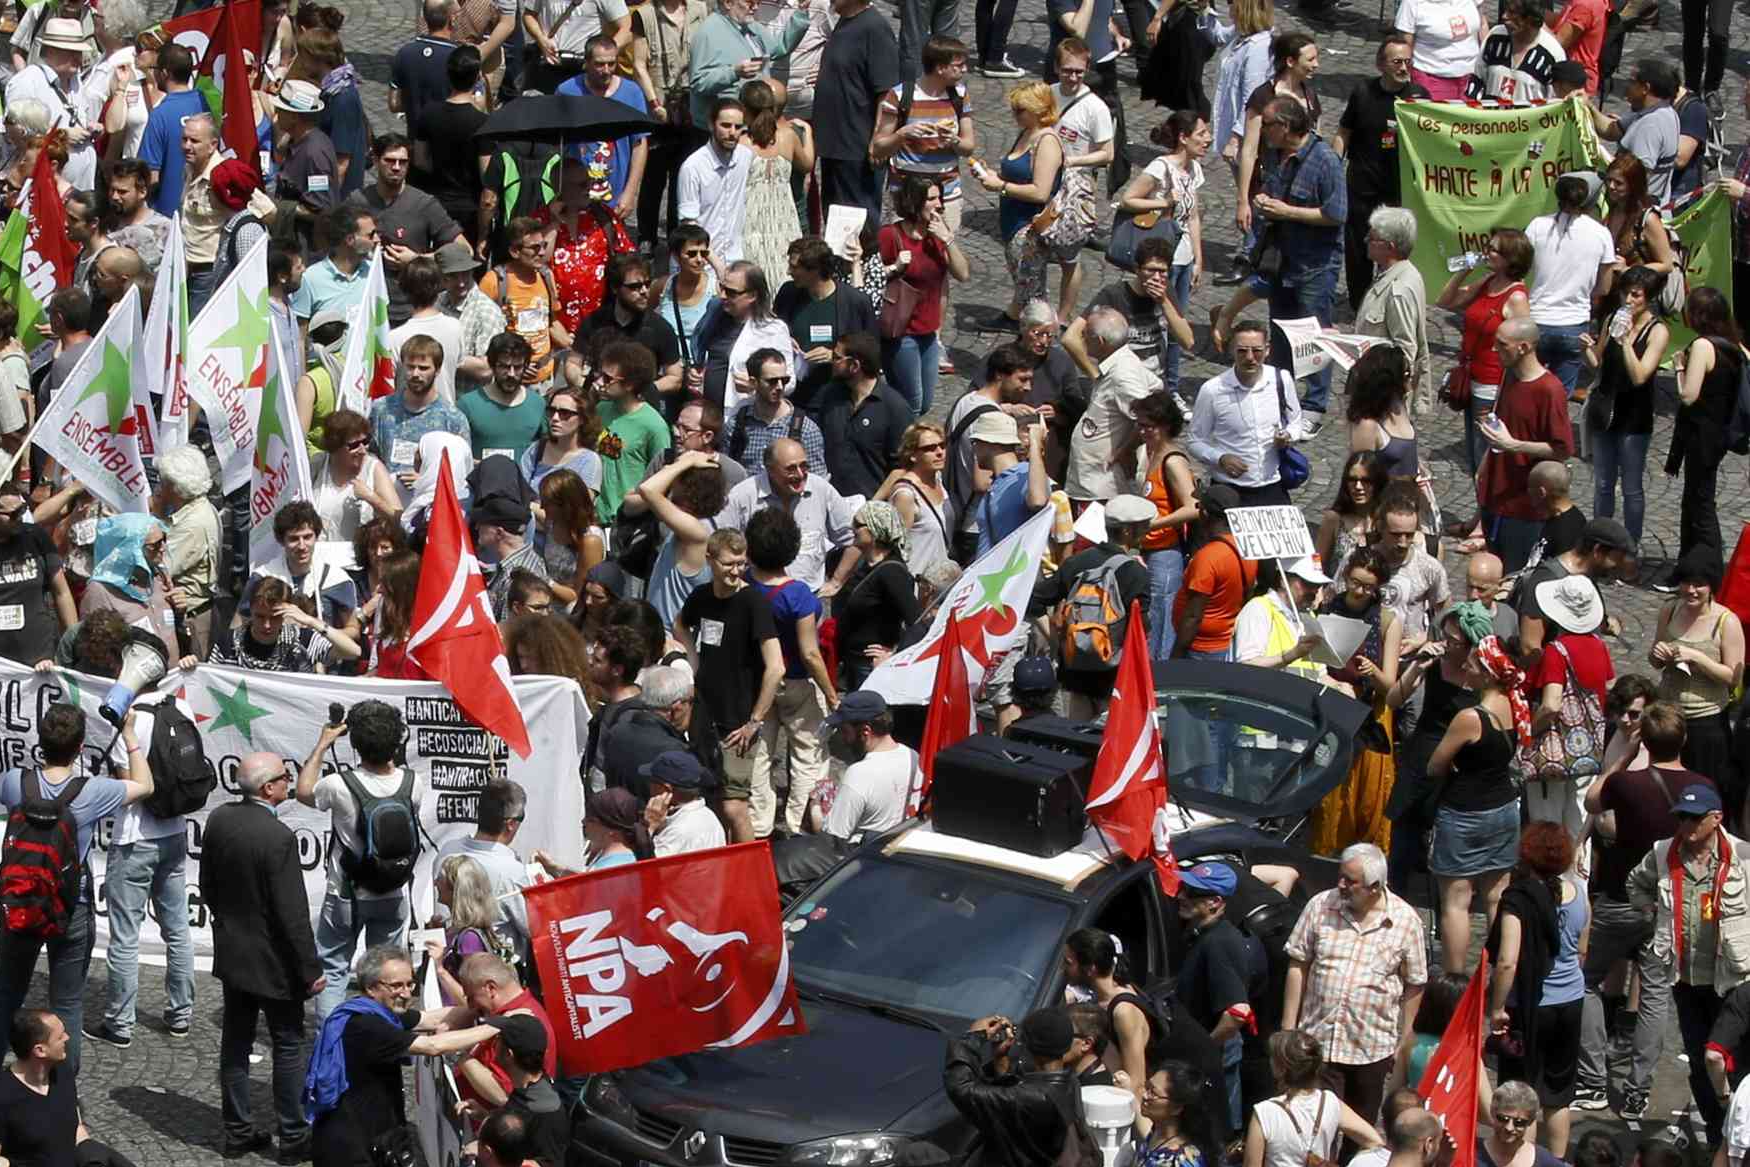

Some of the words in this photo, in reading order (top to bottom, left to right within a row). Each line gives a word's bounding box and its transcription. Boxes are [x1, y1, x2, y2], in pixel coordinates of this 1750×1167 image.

[1450, 116, 1530, 138] personnels
[1425, 163, 1479, 198] HALTE
[1228, 508, 1289, 533] BIENVENUE
[559, 904, 633, 1039] NPA
